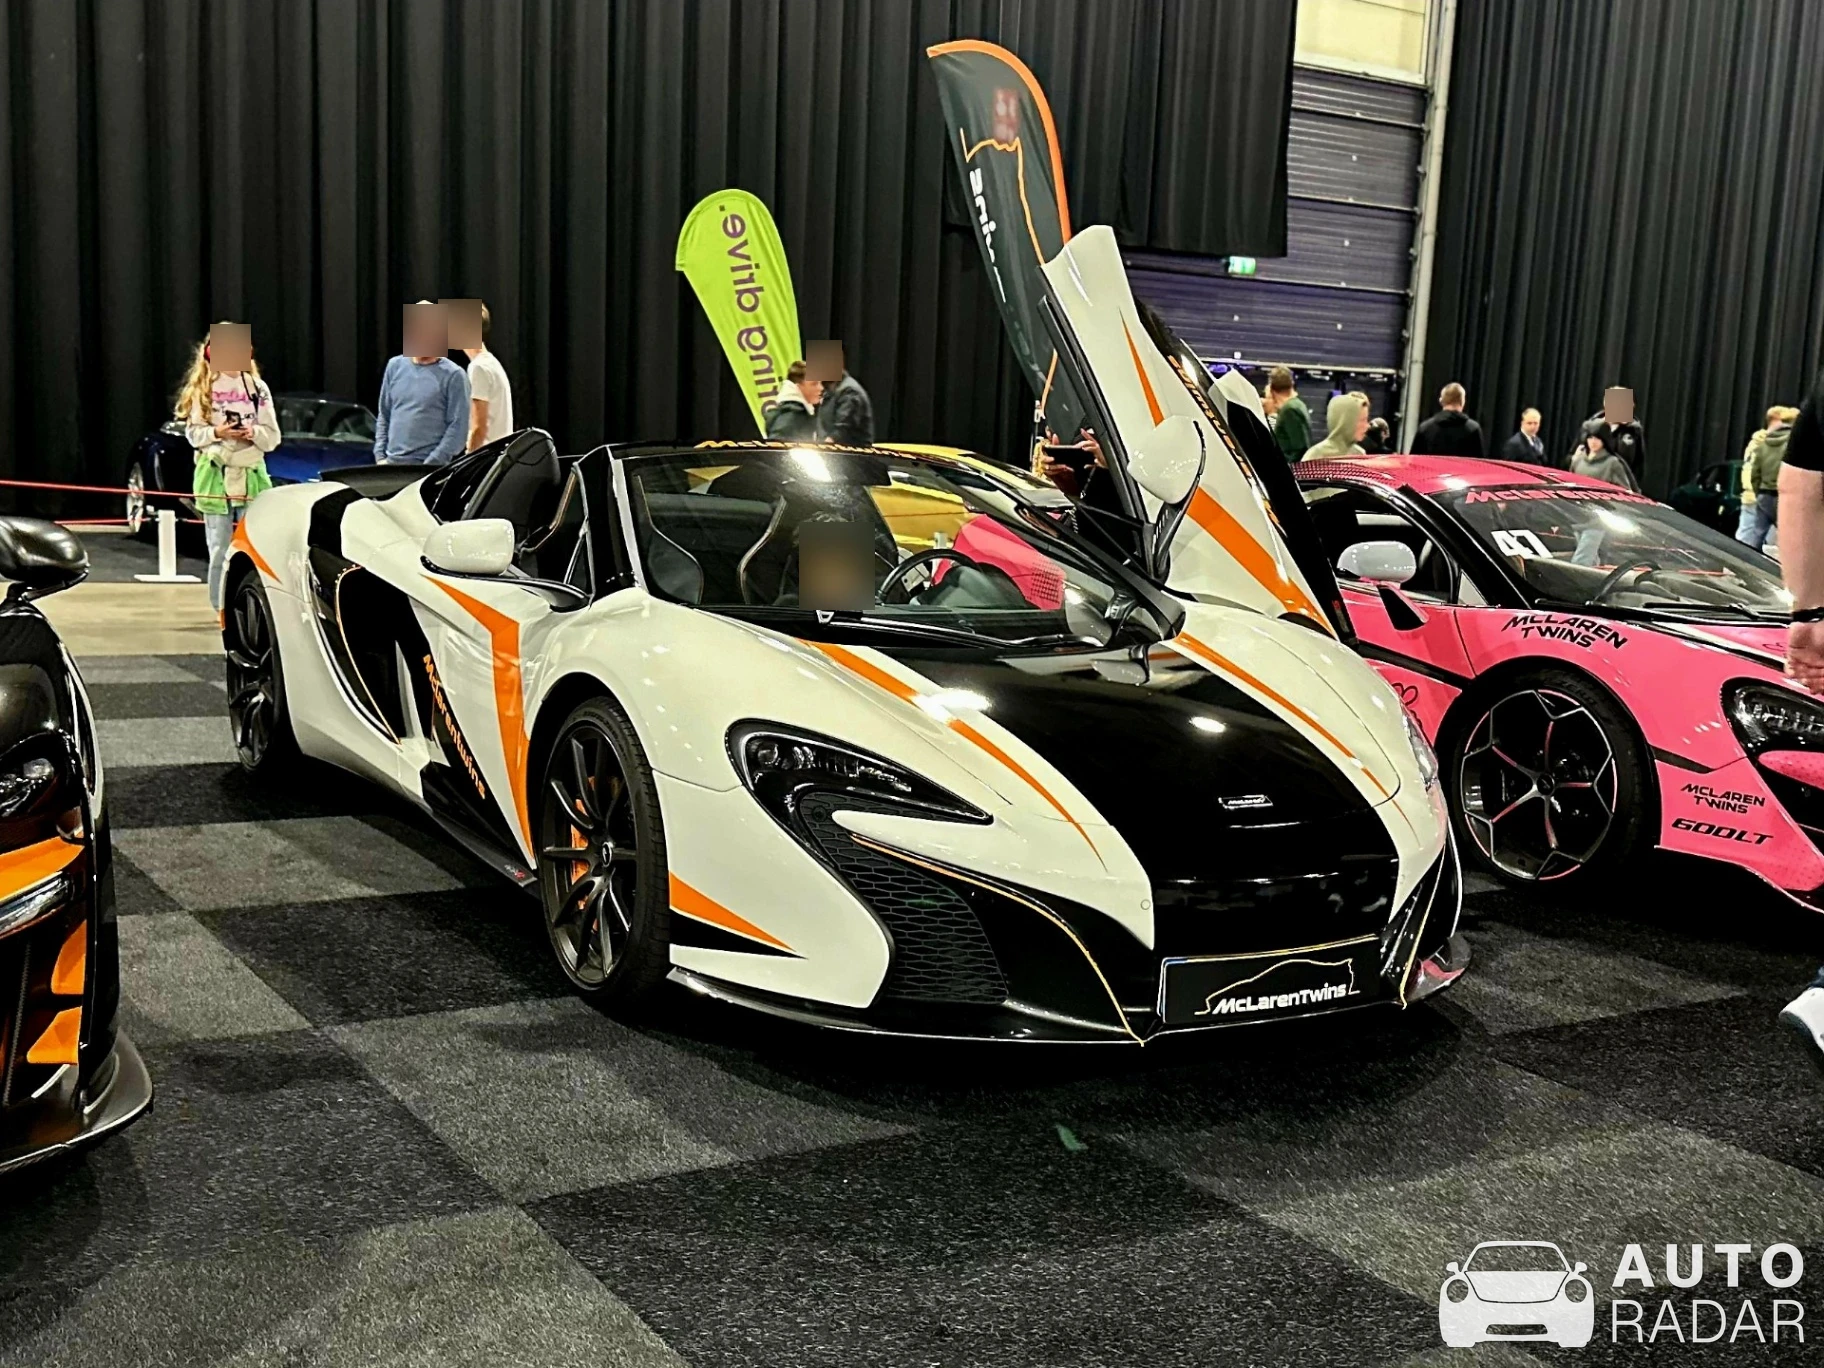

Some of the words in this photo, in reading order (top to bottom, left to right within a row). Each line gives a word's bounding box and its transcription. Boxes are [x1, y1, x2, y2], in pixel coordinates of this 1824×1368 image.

[1491, 529, 1554, 560] 47
[1521, 625, 1597, 648] TWINS
[1681, 783, 1766, 807] MCLAREN
[1694, 795, 1748, 814] TWINS
[1672, 818, 1774, 844] 600LT
